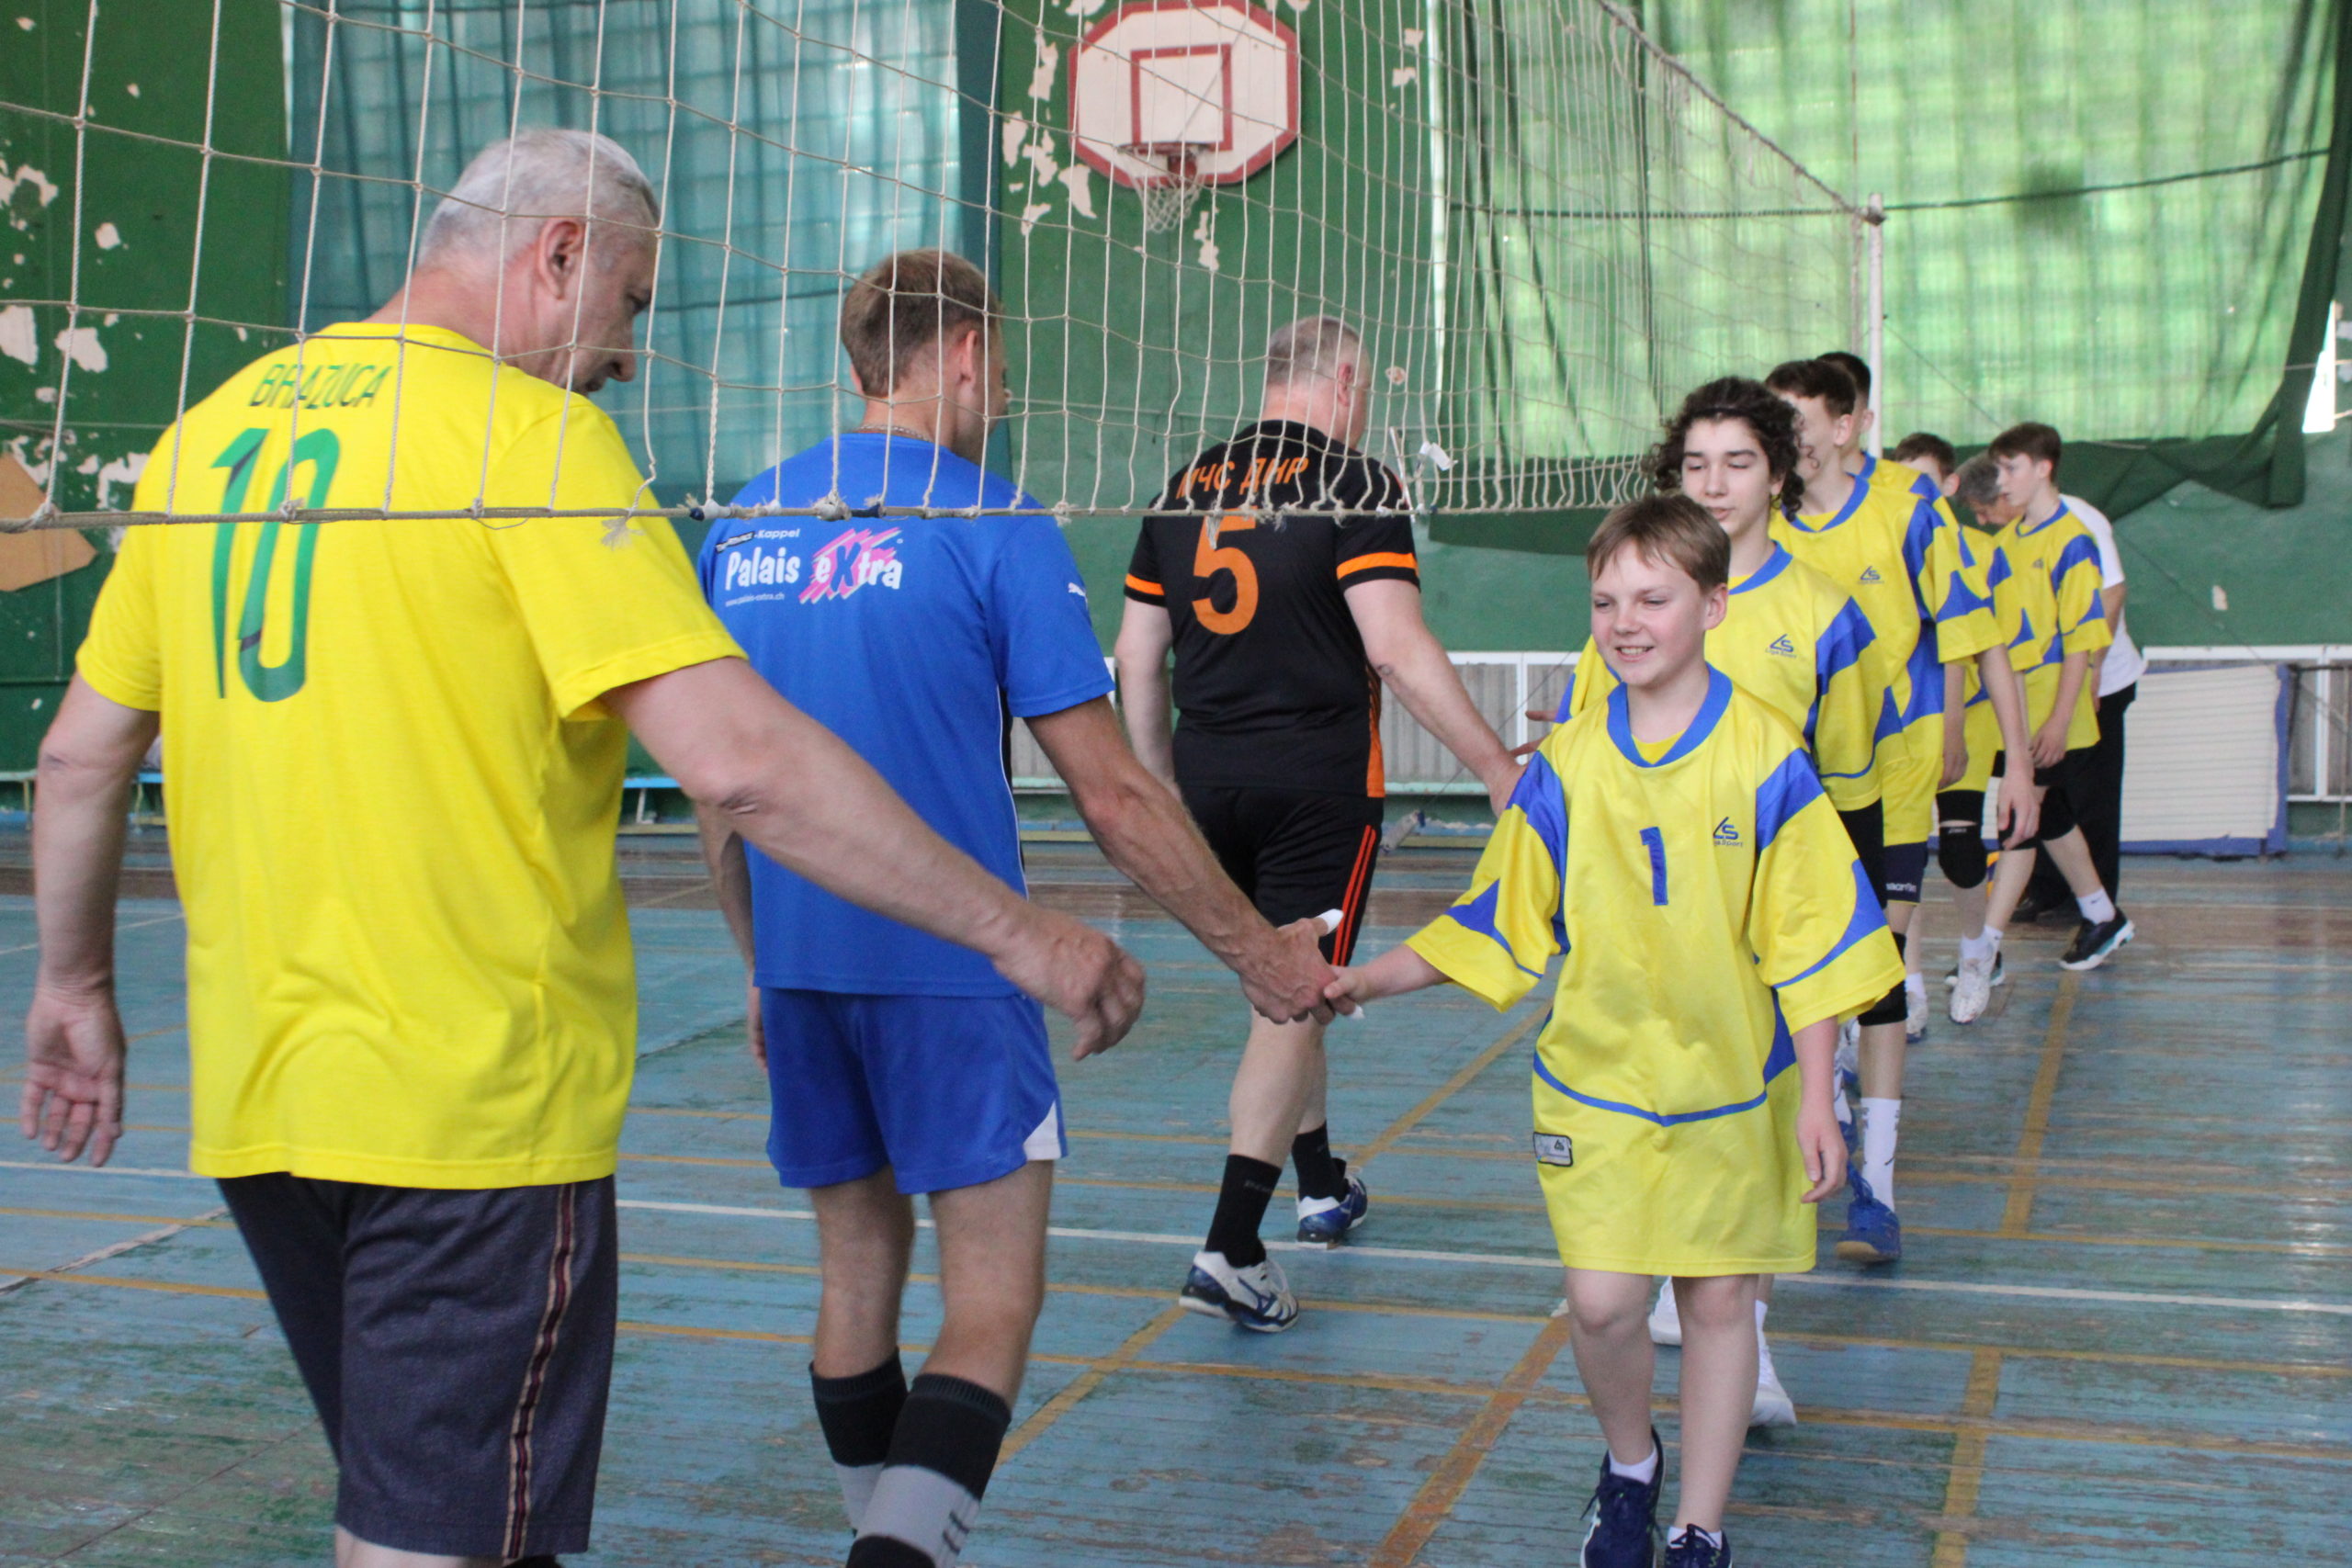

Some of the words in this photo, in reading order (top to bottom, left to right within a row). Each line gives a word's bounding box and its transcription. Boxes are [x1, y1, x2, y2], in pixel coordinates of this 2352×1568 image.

[249, 363, 392, 410] BRAZUCA
[211, 427, 340, 702] 10
[725, 547, 801, 591] Palais
[1192, 505, 1259, 635] 5
[1640, 827, 1668, 906] 1
